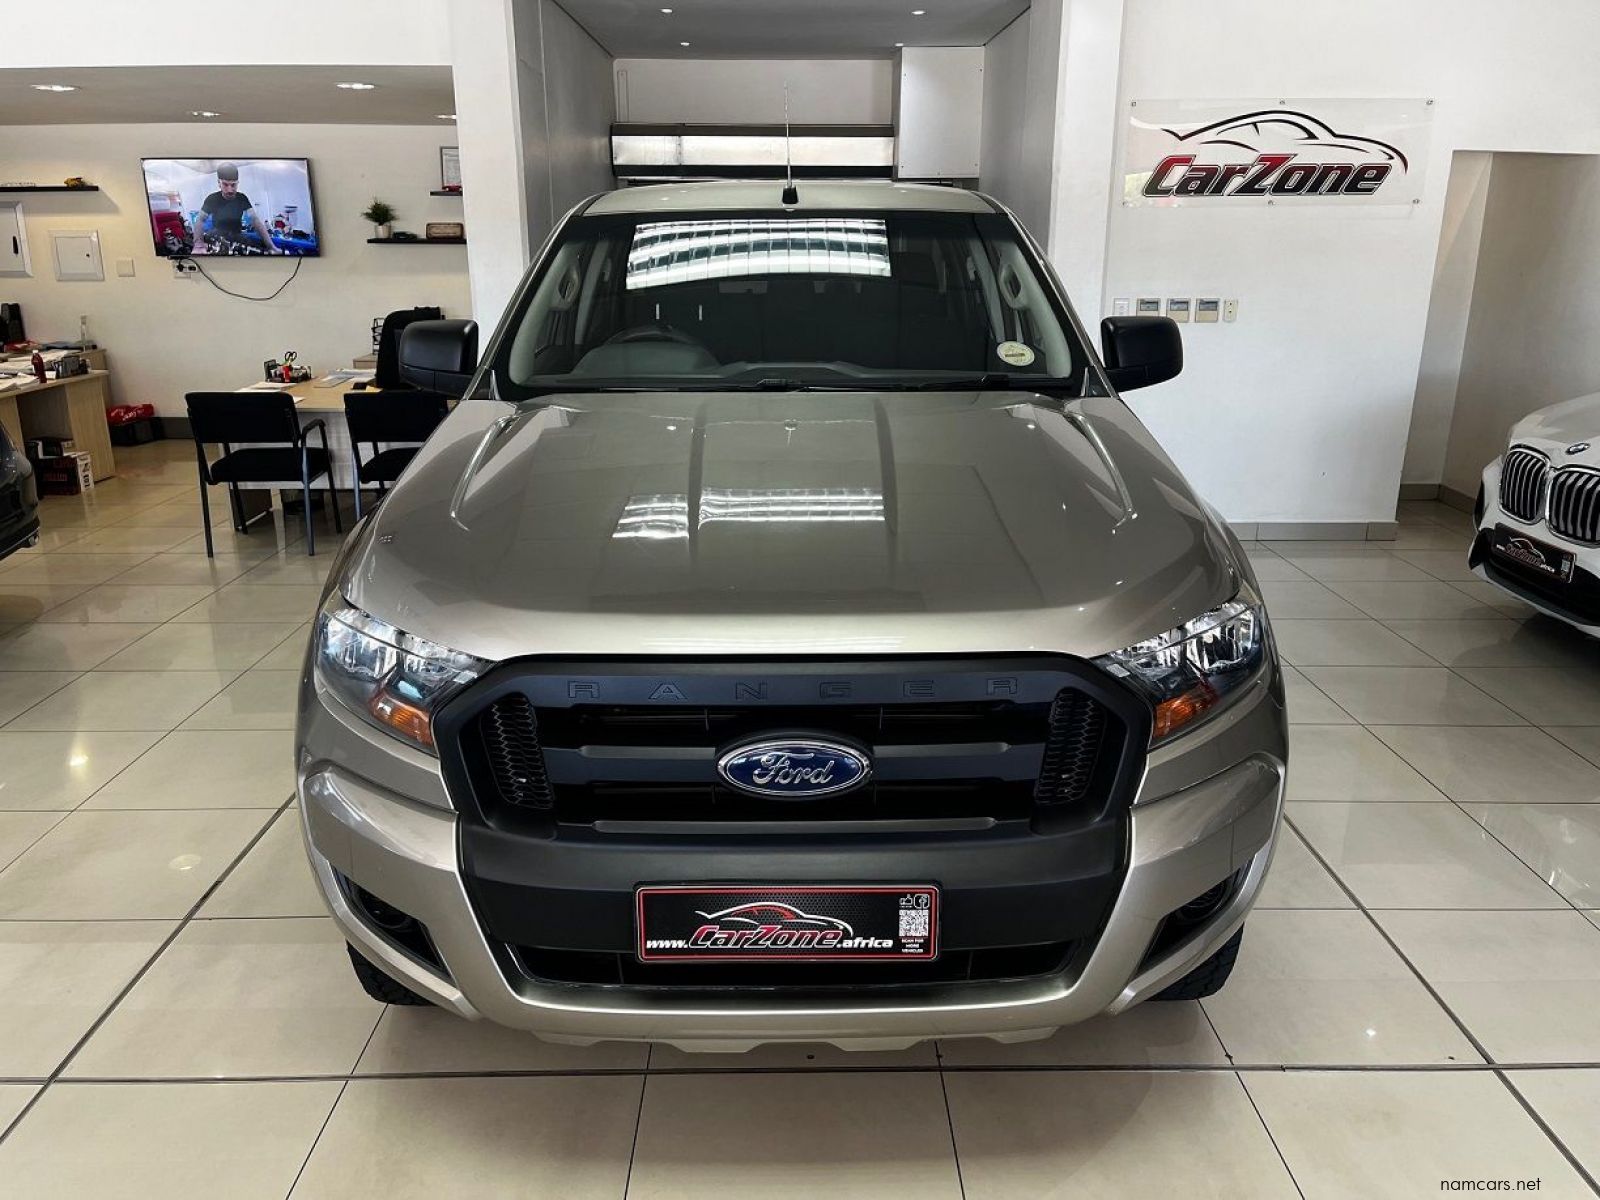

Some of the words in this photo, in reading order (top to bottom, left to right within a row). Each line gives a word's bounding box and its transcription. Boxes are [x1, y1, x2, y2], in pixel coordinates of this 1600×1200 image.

[1142, 153, 1393, 197] CarZone
[568, 679, 1018, 700] RANGER
[752, 751, 834, 785] Ford
